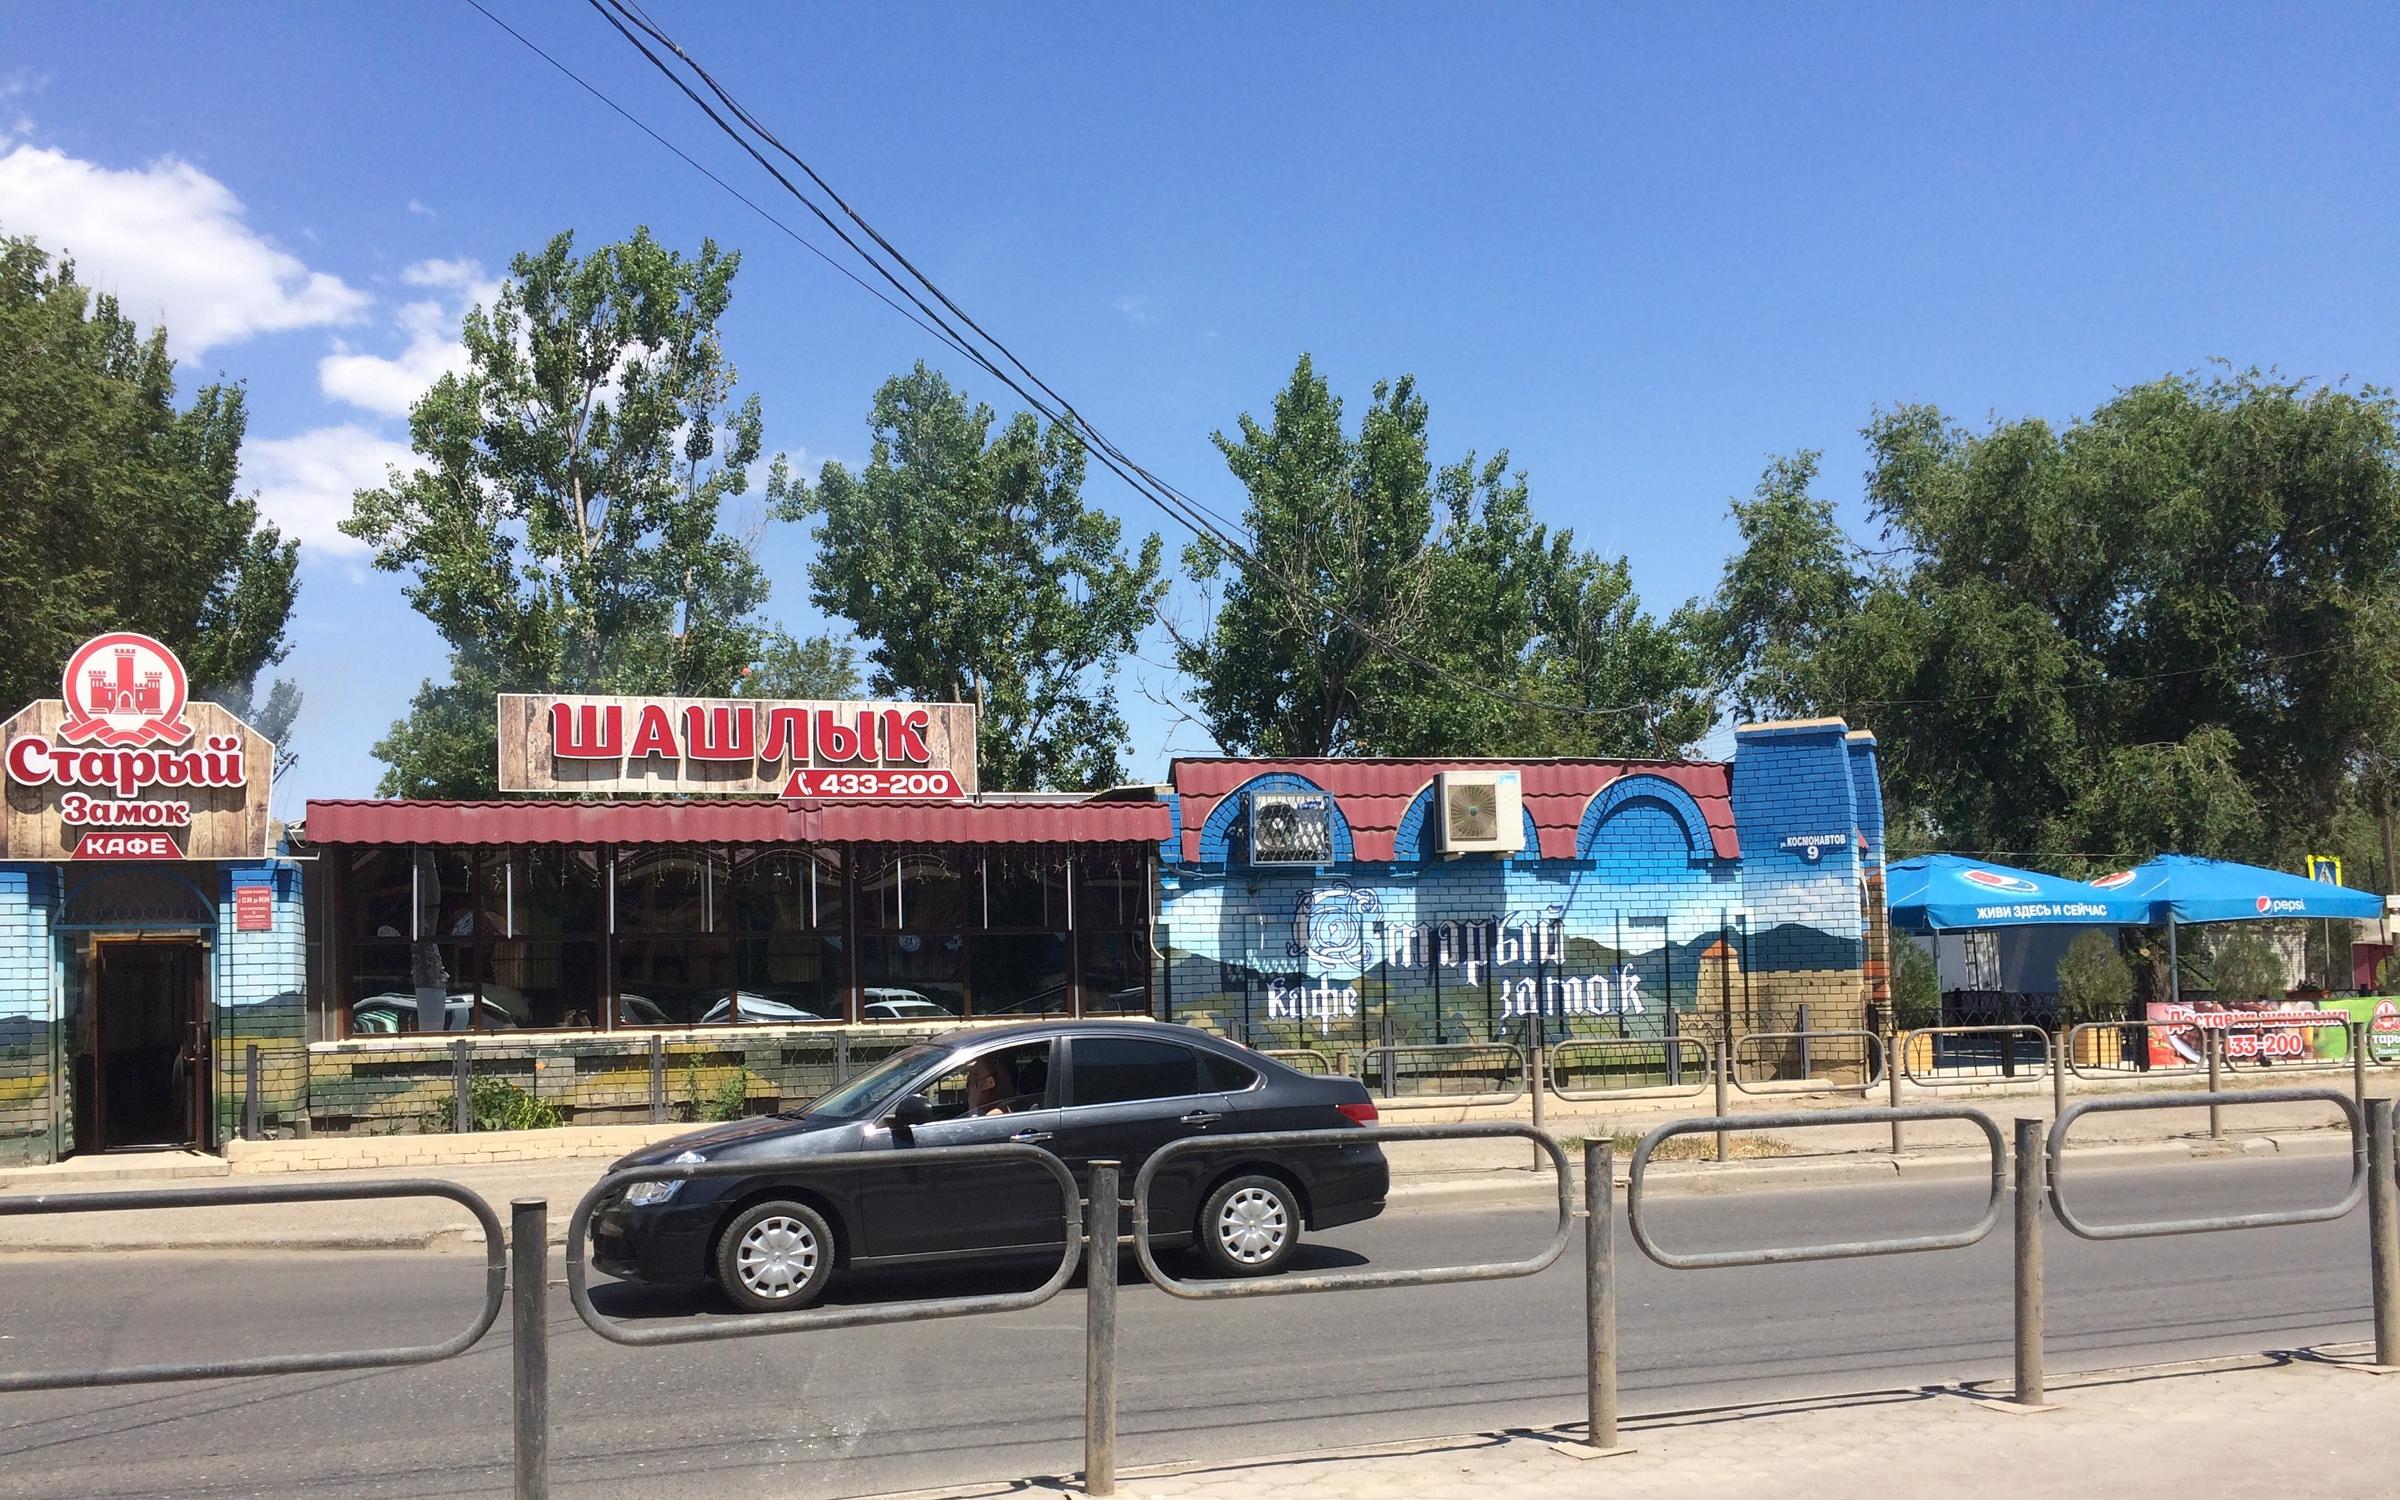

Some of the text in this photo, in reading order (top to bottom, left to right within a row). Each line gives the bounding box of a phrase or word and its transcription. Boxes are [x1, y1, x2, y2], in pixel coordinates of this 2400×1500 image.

[550, 702, 932, 764] ШАШЛЫК
[6, 735, 246, 796] Старый
[819, 773, 949, 795] 433-200
[61, 793, 189, 825] Замок
[87, 838, 168, 855] КАФЕ
[1787, 834, 1846, 847] КОСМОНАВТОВ
[1807, 846, 1819, 860] 9
[1976, 902, 2107, 919] ЖИВИ ЗДЕСЬ И СЕЙЧАС
[2273, 898, 2306, 912] pepsi
